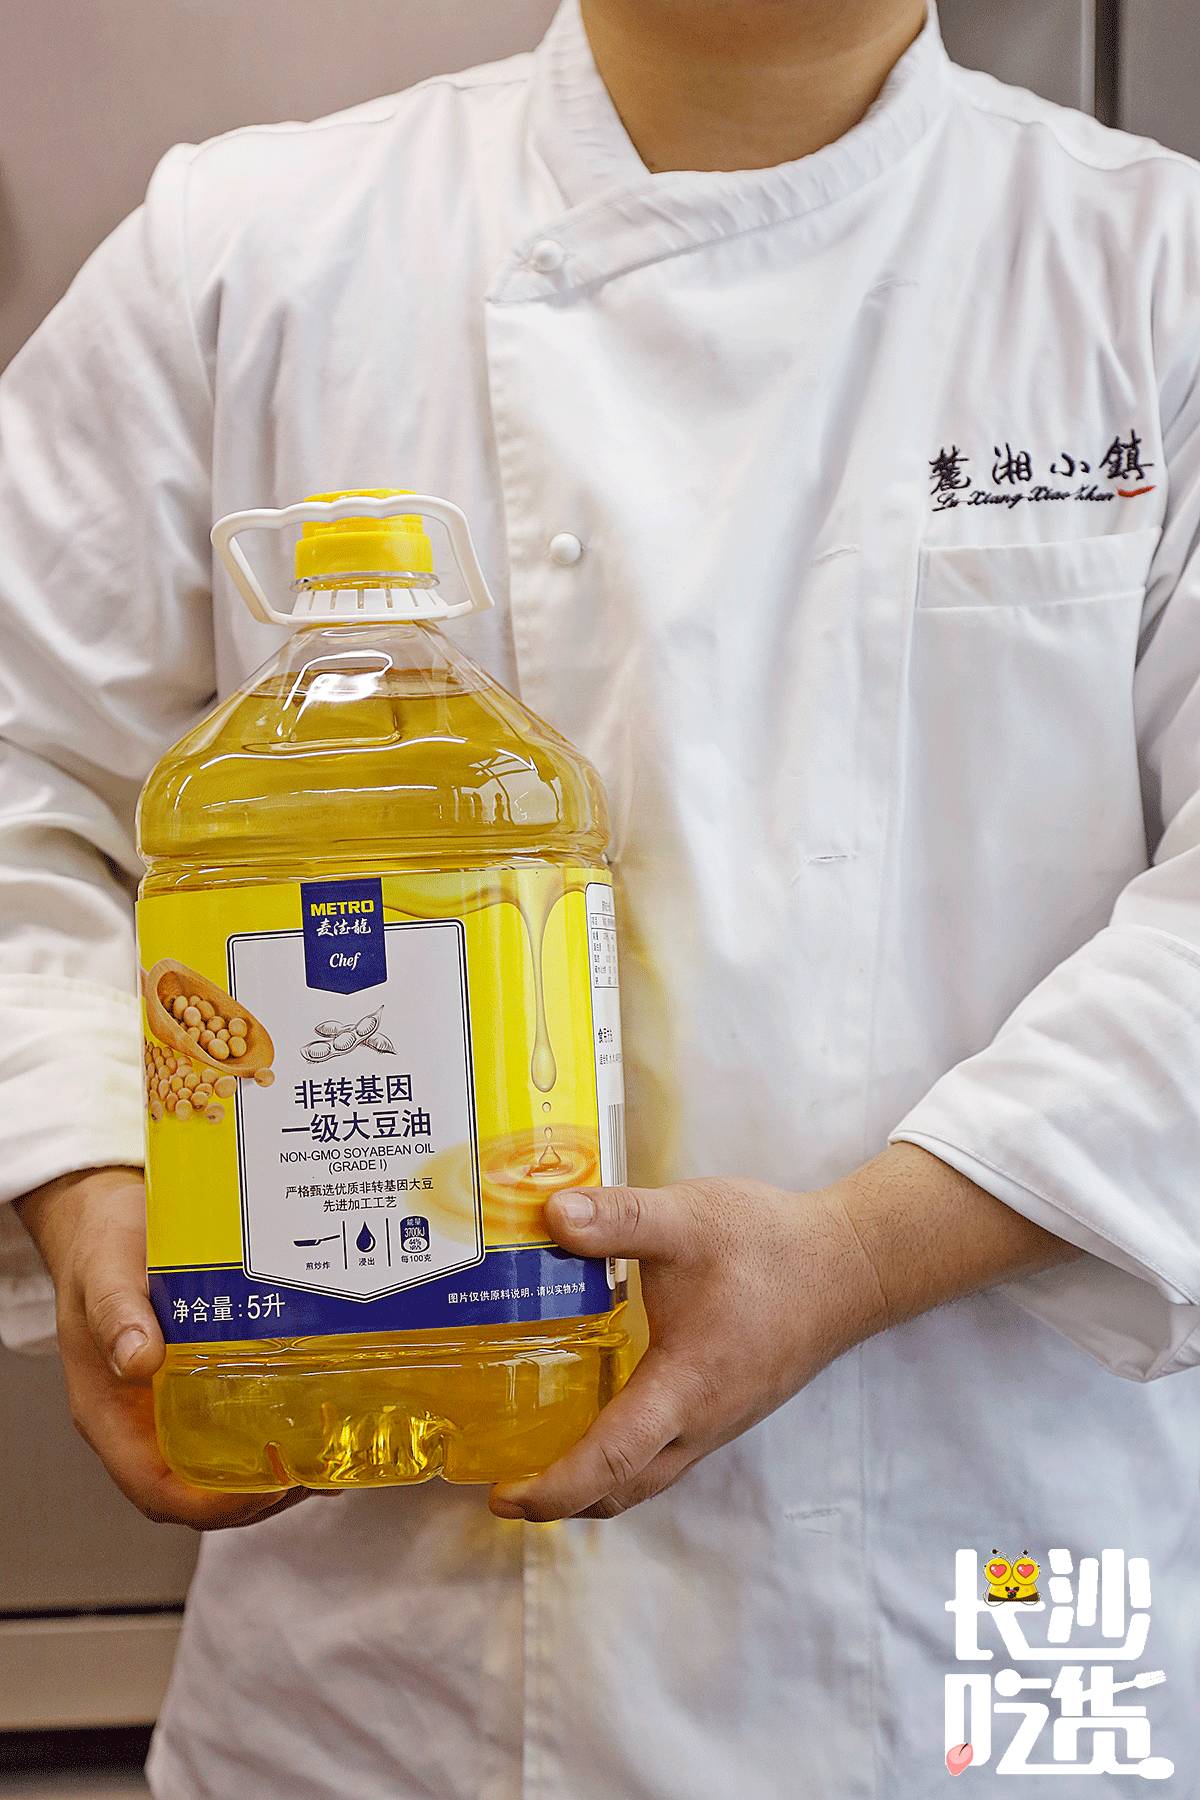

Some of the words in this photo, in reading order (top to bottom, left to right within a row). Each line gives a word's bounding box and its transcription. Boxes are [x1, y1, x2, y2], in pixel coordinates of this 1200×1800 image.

[310, 900, 375, 917] METRO
[329, 952, 361, 971] Chef
[294, 1074, 413, 1110] 非转基因
[281, 1107, 432, 1143] 一级大豆油
[279, 1149, 341, 1164] NON-GMO
[343, 1144, 412, 1160] SOYABEAN
[414, 1143, 435, 1155] OIL
[328, 1160, 376, 1175] (GRADE
[285, 1177, 434, 1200] 严格甄选优质非转基因大豆
[323, 1196, 397, 1213] 先进加工工艺
[358, 1257, 376, 1267] 浸出
[401, 1253, 432, 1264] 每100克
